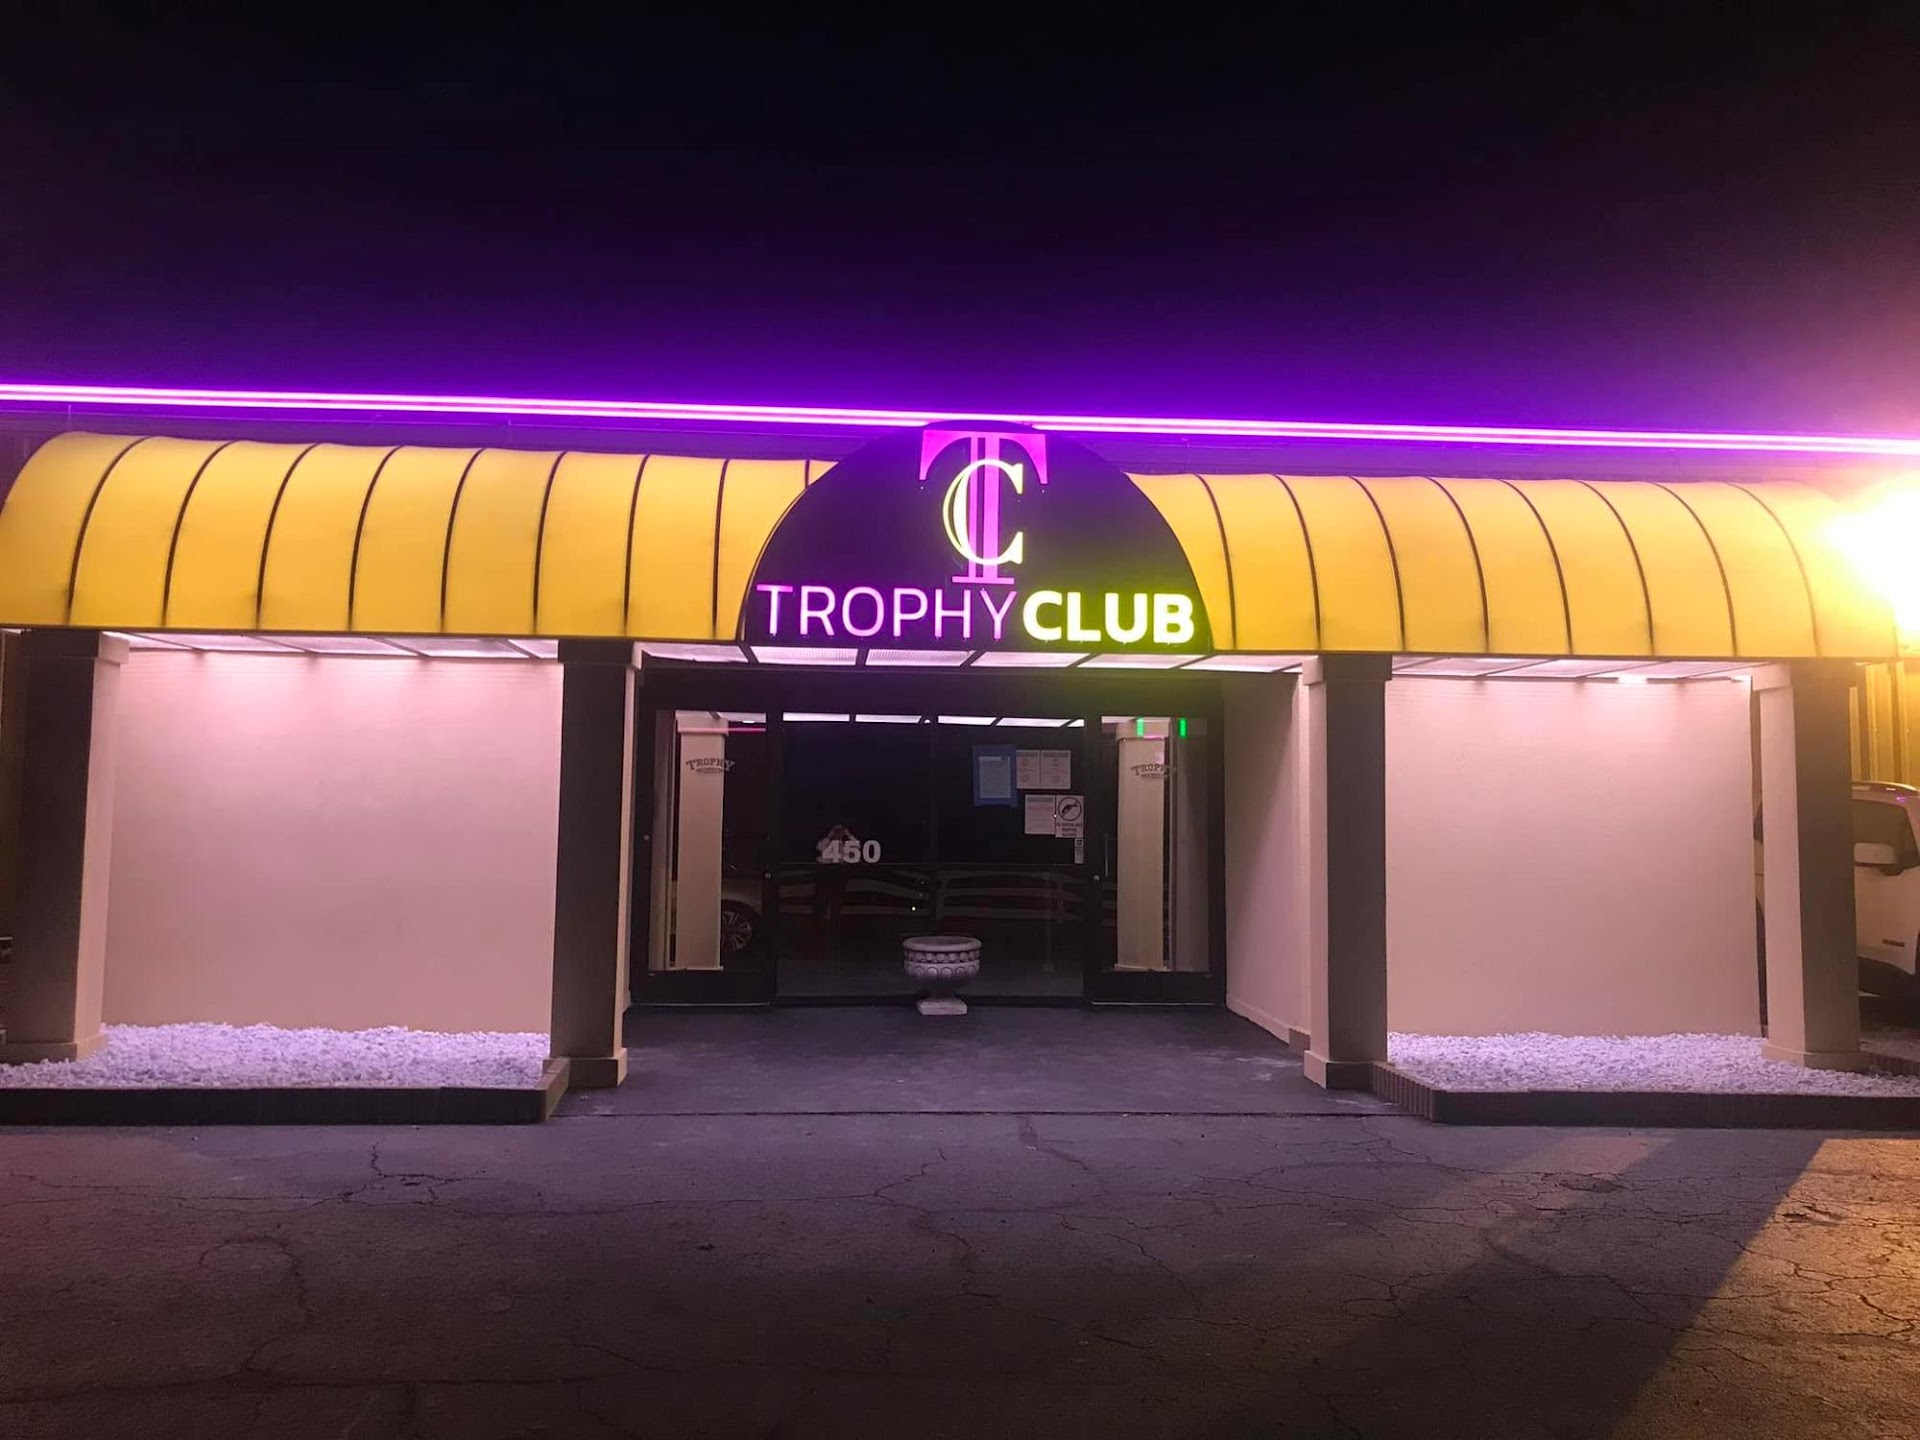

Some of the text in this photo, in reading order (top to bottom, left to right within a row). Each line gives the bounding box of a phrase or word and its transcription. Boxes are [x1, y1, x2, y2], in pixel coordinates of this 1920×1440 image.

[756, 585, 1195, 644] TROPHY CLUB
[822, 839, 882, 863] 450
